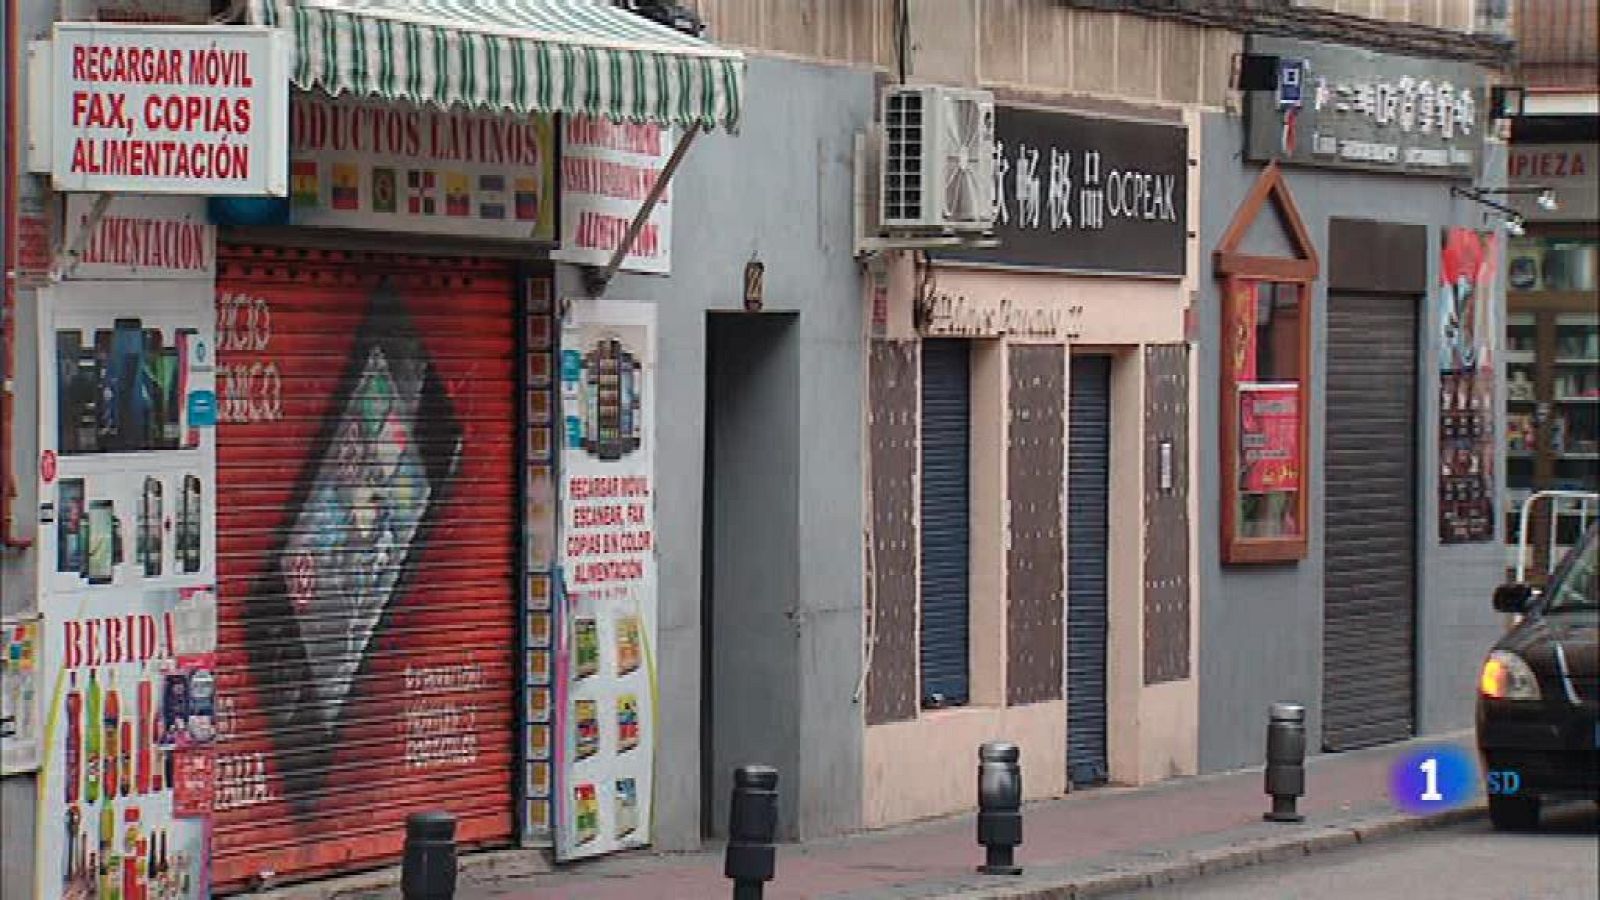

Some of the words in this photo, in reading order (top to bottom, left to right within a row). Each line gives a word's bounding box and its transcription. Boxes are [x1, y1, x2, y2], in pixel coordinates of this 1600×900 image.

[72, 46, 182, 85] RECARGAR
[189, 41, 252, 88] MÓVIL
[72, 91, 135, 136] FAX,
[144, 95, 250, 133] COPIAS
[427, 110, 537, 167] LATINOS
[70, 134, 248, 181] ALIMENTACIÓN
[1106, 169, 1175, 223] OCPEAK
[82, 214, 204, 269] LIMENTACIÓN
[64, 612, 176, 669] BEBIDA
